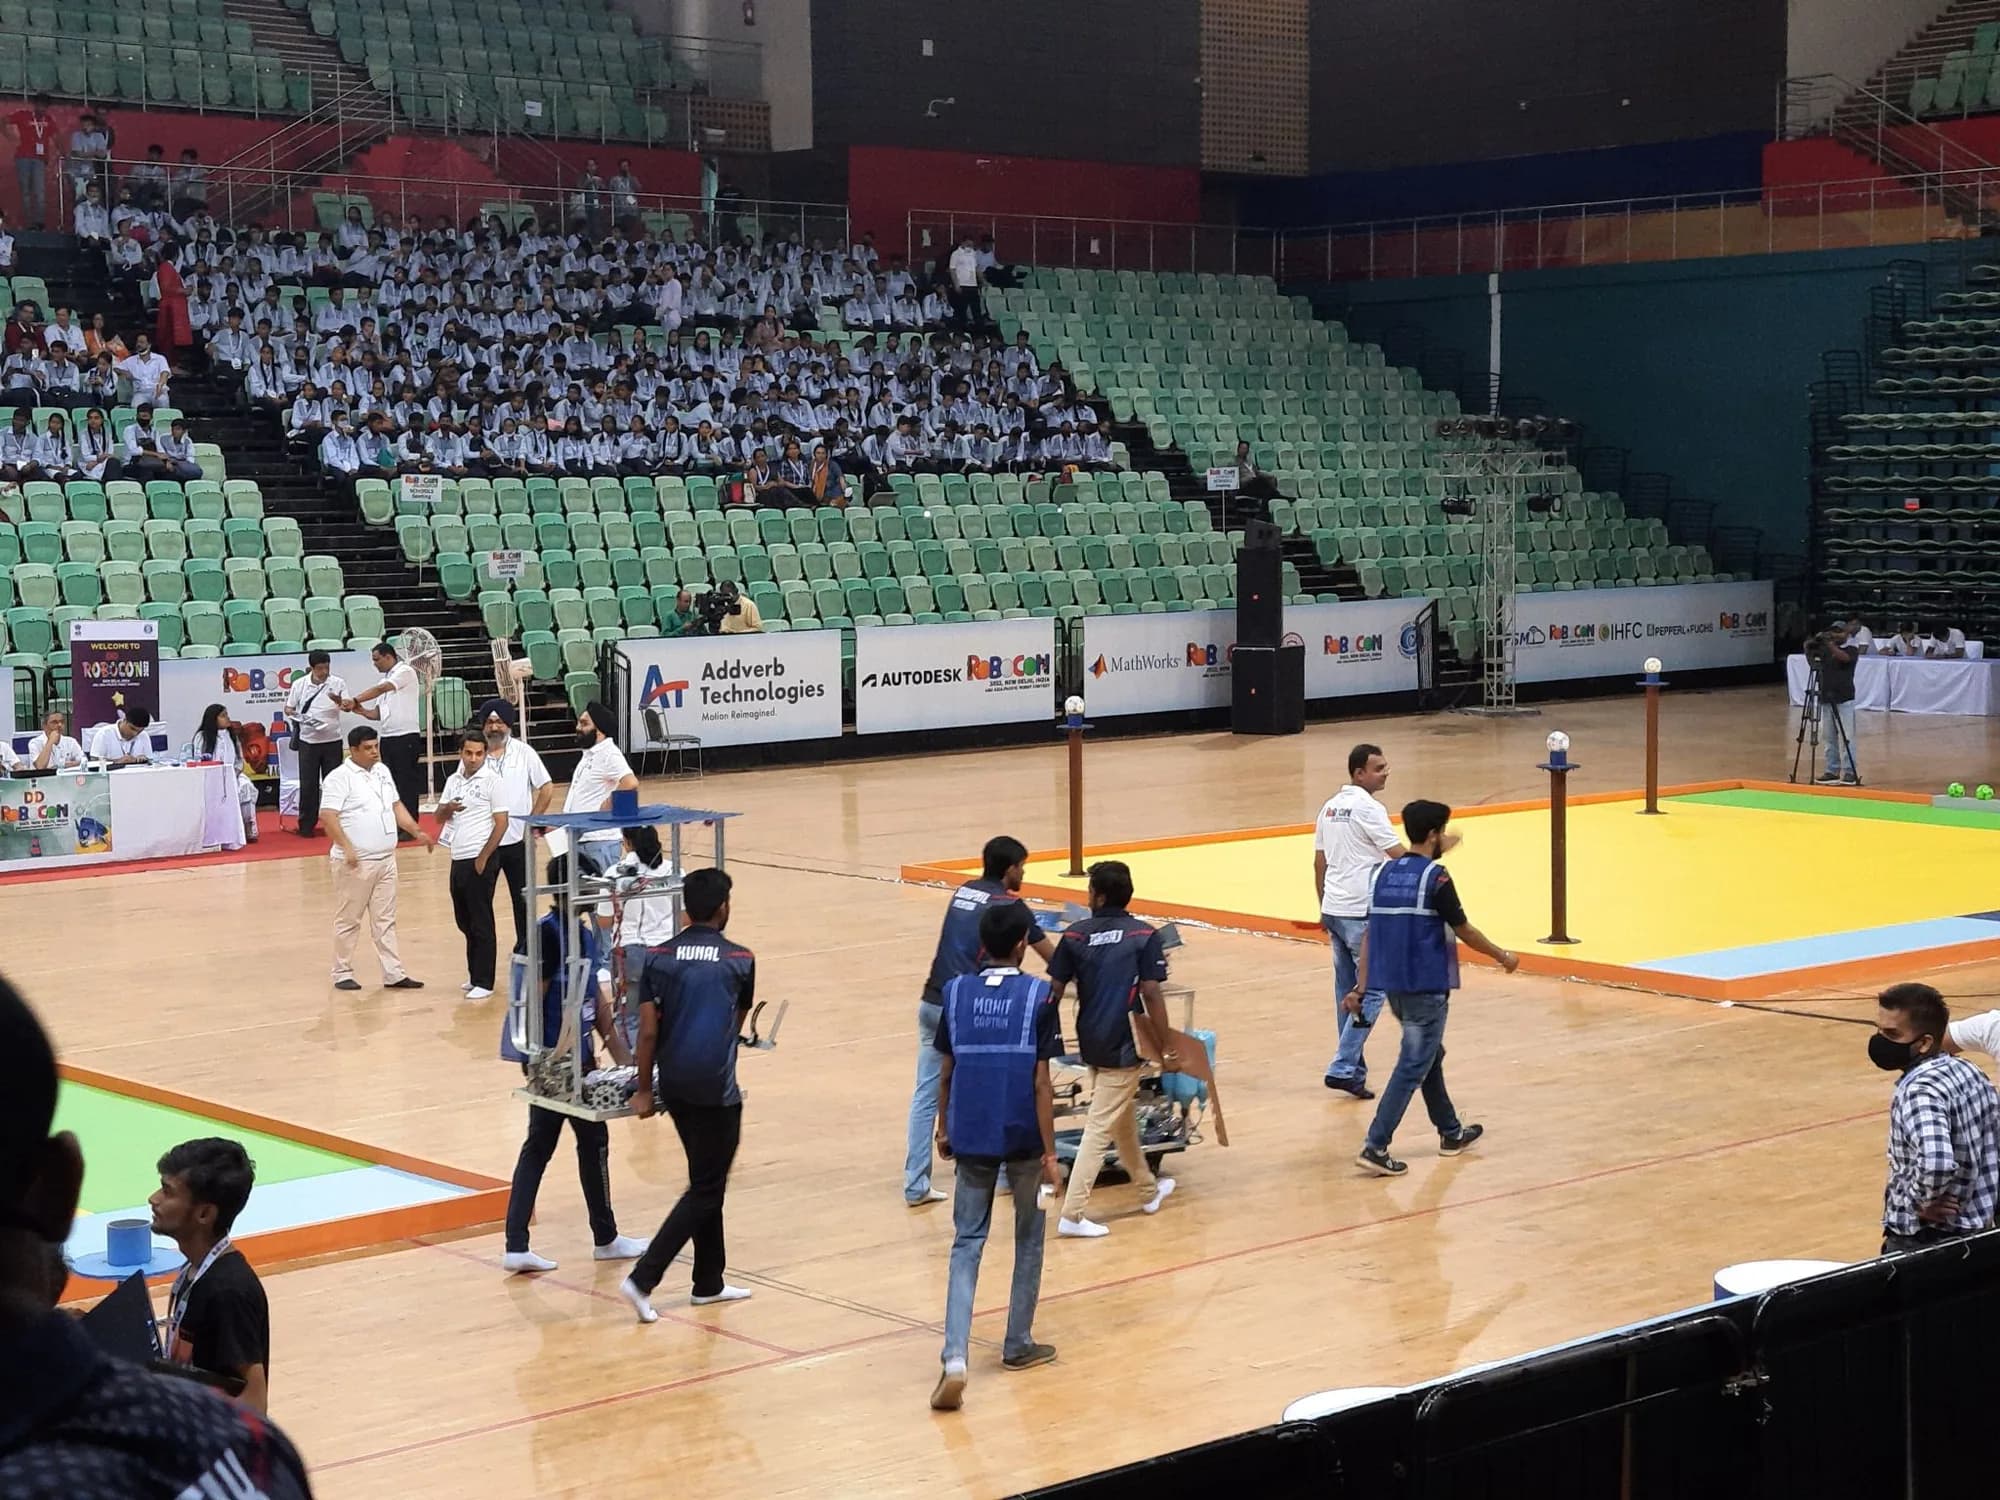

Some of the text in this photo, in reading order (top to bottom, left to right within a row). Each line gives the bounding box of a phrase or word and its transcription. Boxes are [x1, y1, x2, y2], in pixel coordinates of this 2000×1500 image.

[1720, 611, 1767, 630] ROBCON
[1549, 624, 1594, 640] ROBCON
[1611, 621, 1643, 641] IHFC
[1323, 634, 1382, 655] ROBCON
[701, 656, 785, 682] Addverb
[967, 653, 1050, 681] ROBOCON
[1110, 653, 1180, 673] MathWorks
[881, 668, 963, 687] AUTODESK
[700, 679, 825, 705] Technologies
[701, 710, 729, 721] Motion
[24, 791, 45, 804] DD
[676, 945, 720, 962] KUNAL
[973, 997, 1012, 1015] MOHIT
